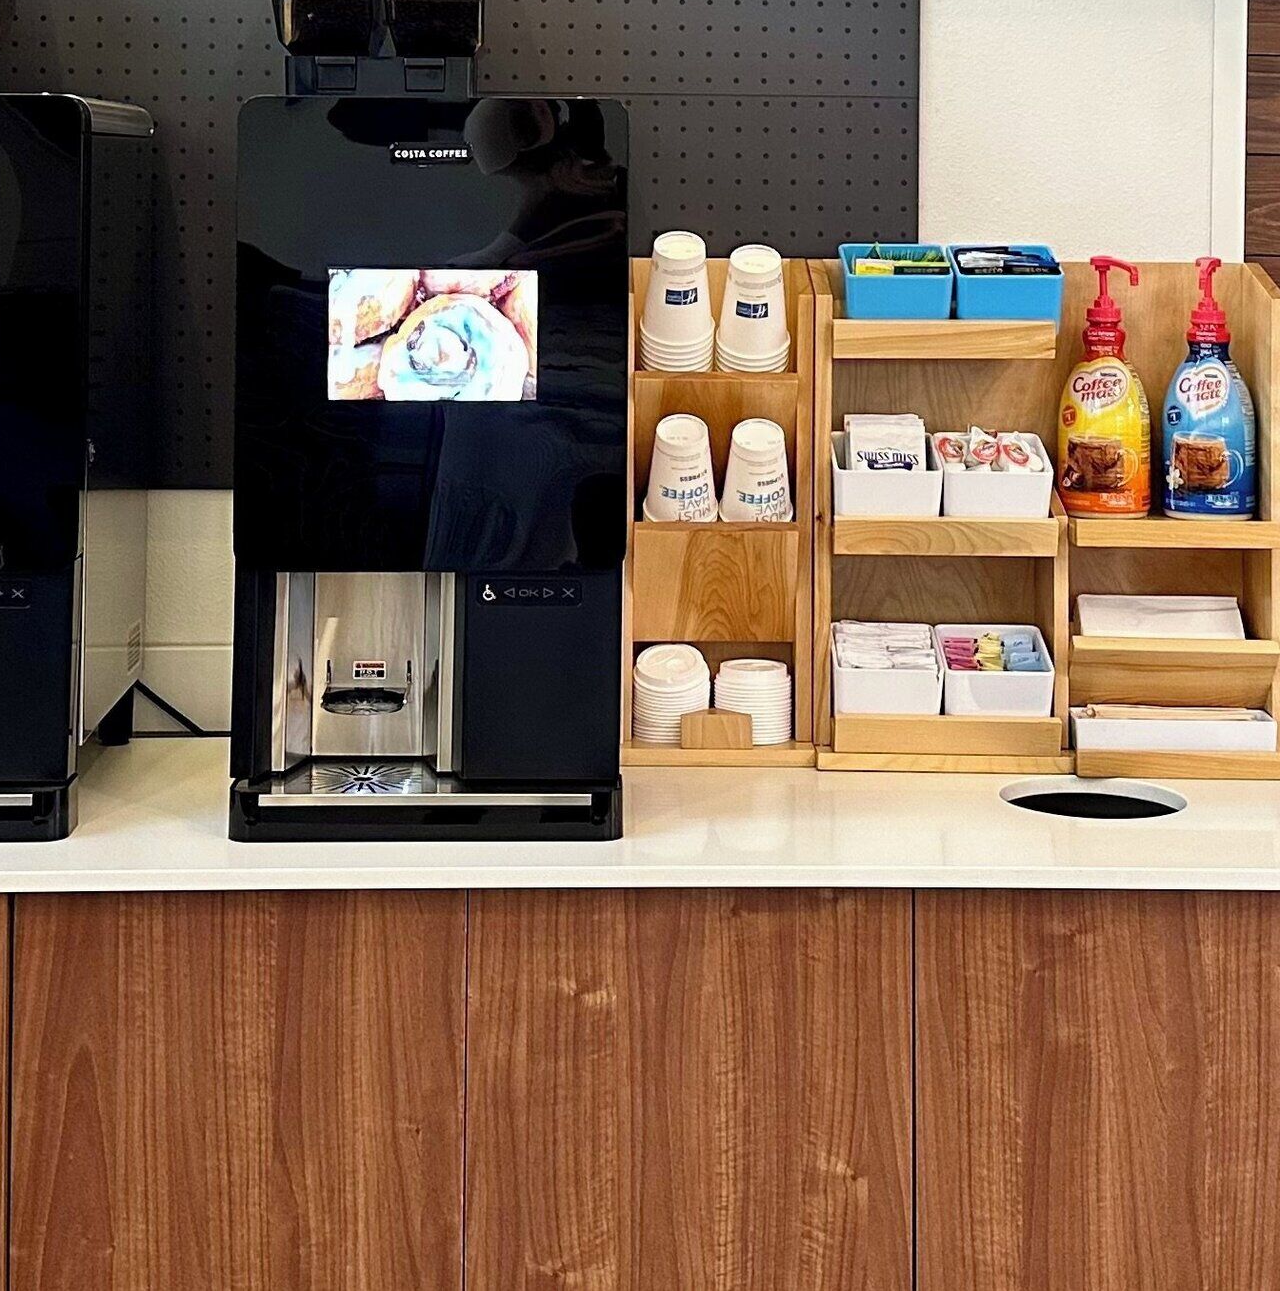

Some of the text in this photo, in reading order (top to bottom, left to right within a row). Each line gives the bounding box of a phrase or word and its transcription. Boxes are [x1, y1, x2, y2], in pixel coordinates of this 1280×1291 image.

[394, 149, 468, 159] COSTA COFFEE
[1072, 376, 1122, 394] Coffee
[518, 588, 540, 598] OK
